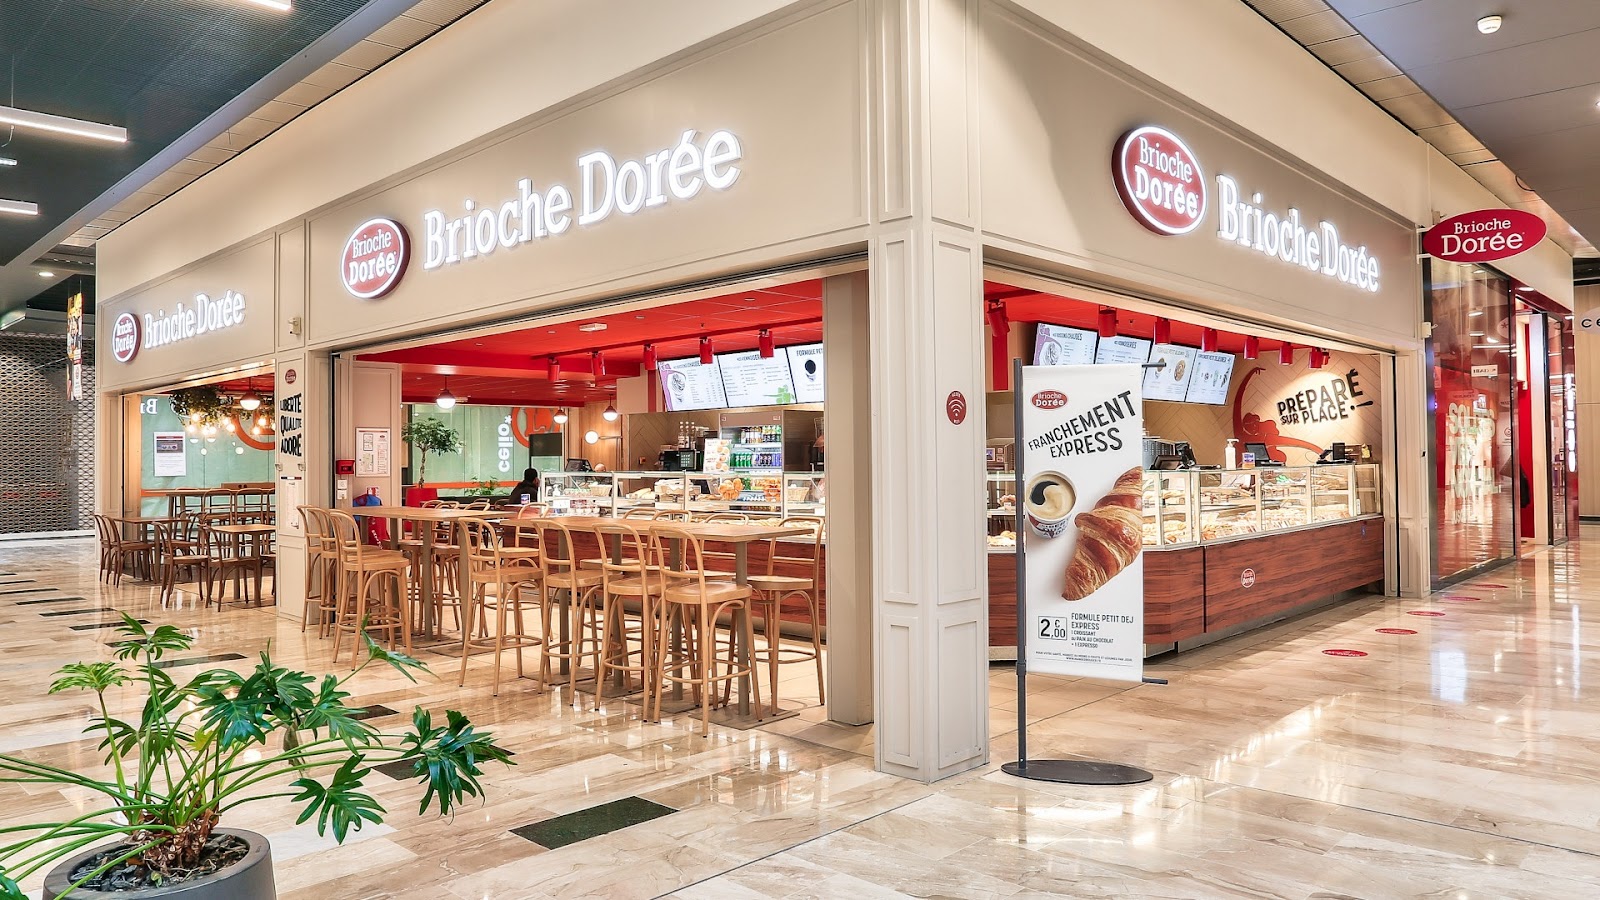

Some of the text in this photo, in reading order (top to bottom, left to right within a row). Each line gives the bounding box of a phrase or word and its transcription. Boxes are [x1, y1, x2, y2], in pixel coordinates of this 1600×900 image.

[1139, 136, 1193, 183] Brioche
[423, 129, 742, 270] Brioche Dorée
[1134, 166, 1198, 219] Dorée
[1215, 174, 1380, 292] Brioche Dorée
[1454, 218, 1511, 234] Brioche
[352, 229, 392, 259] Brioche
[1441, 232, 1523, 256] Dorée
[348, 252, 396, 286] Dorée
[144, 290, 245, 349] Brioche Dorée
[1035, 398, 1064, 407] Dorée
[1277, 368, 1364, 417] PRÉPARÉ
[1028, 390, 1136, 451] FRANCHEMENT
[1280, 412, 1300, 425] SUR
[1050, 427, 1123, 458] EXPRESS
[1071, 612, 1134, 624] FORMULE PETIT DEJ
[1071, 621, 1100, 631] EXPRESS
